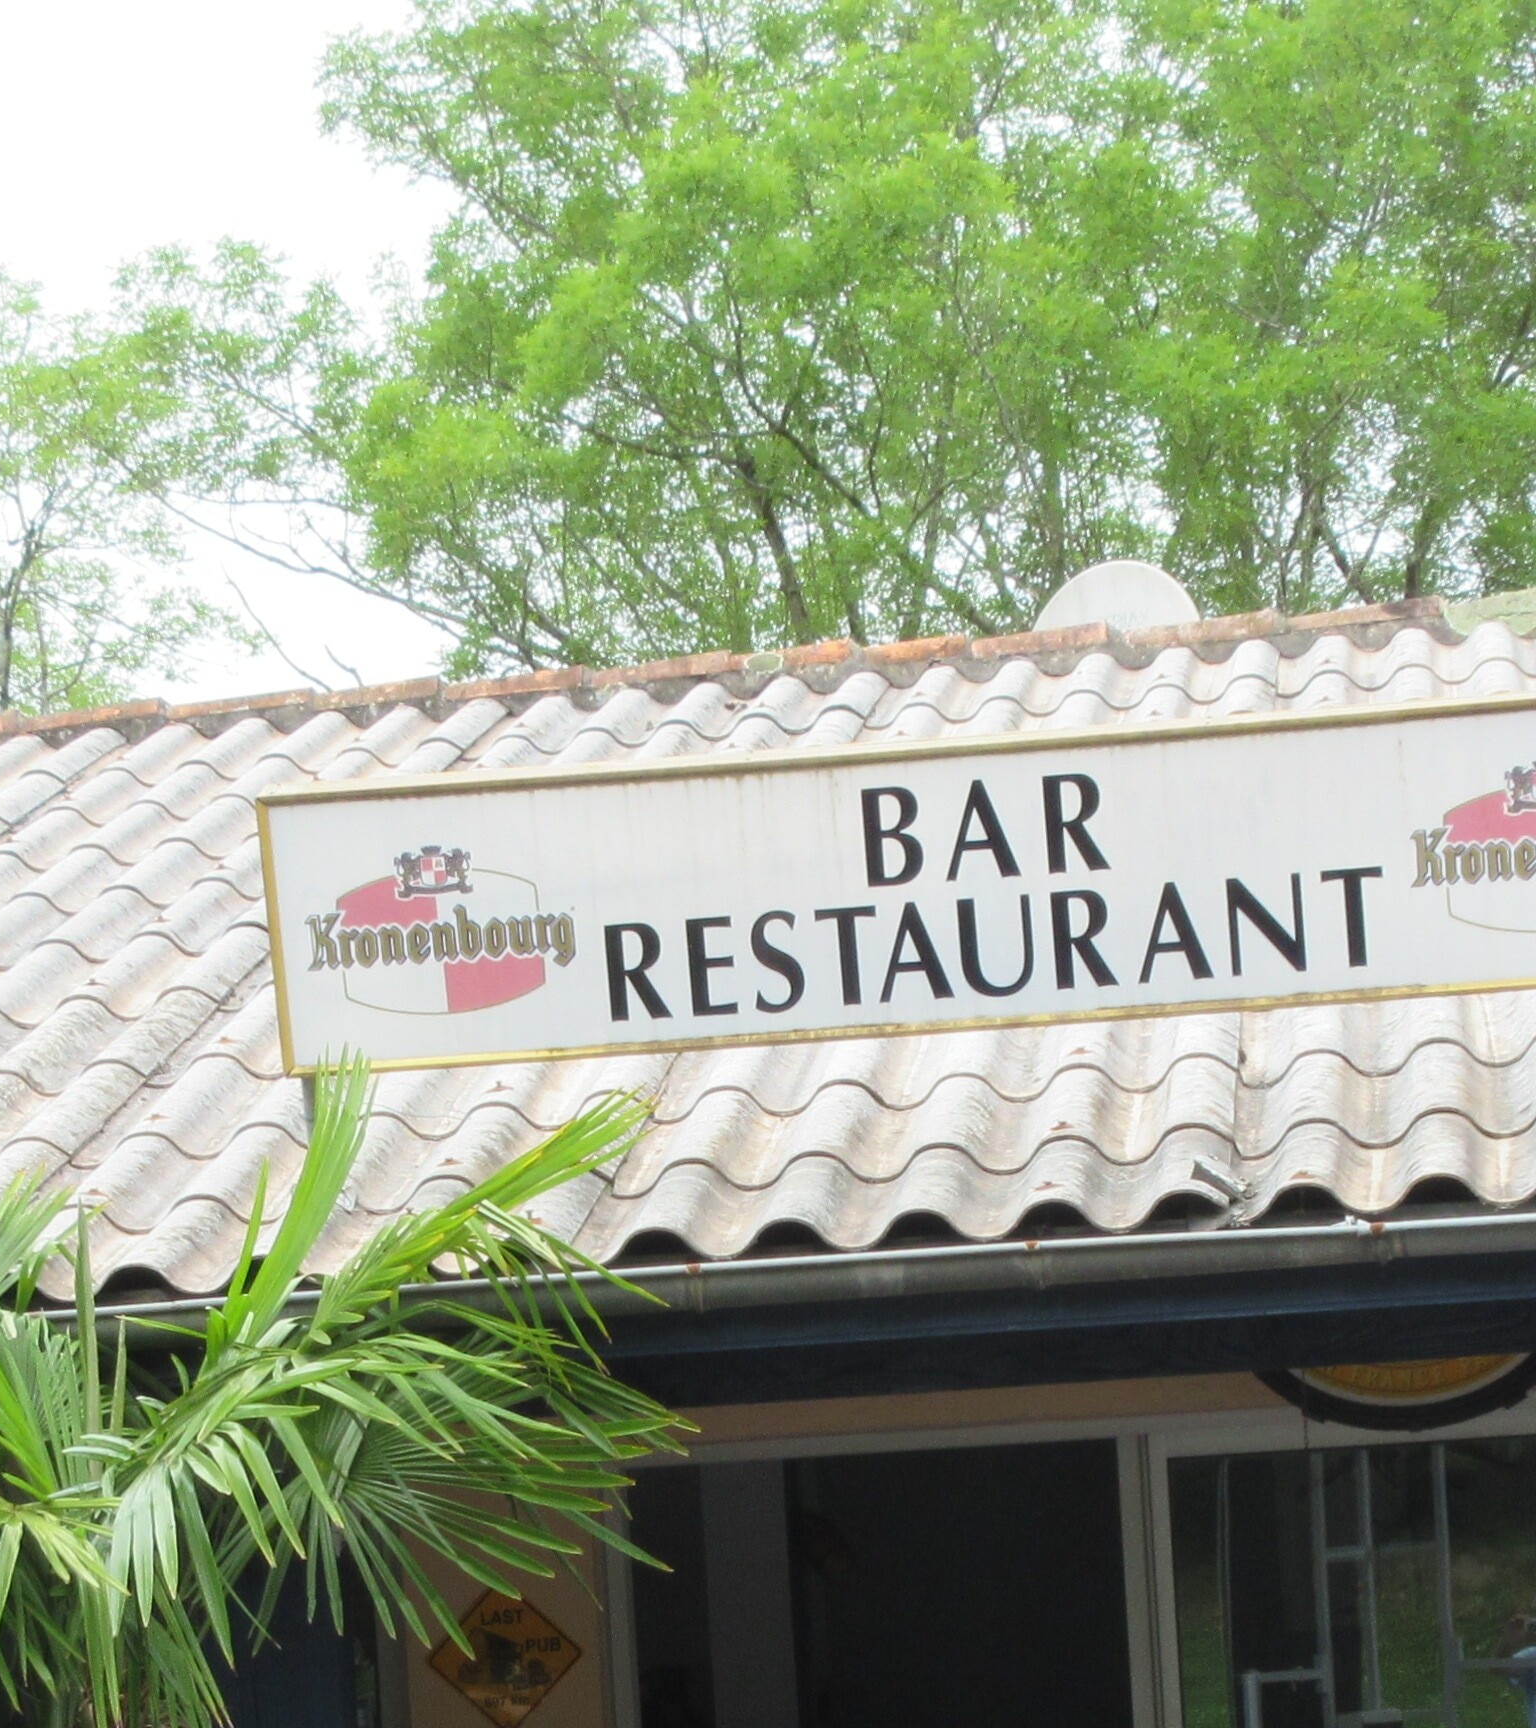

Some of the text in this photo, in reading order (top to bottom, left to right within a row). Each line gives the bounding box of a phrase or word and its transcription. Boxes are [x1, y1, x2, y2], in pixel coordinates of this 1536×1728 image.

[861, 772, 1112, 888] BAR
[305, 904, 576, 971] Kronenbourg
[604, 865, 1385, 1022] RESTAURANT
[480, 1608, 525, 1626] LAST
[525, 1637, 561, 1652] PUB
